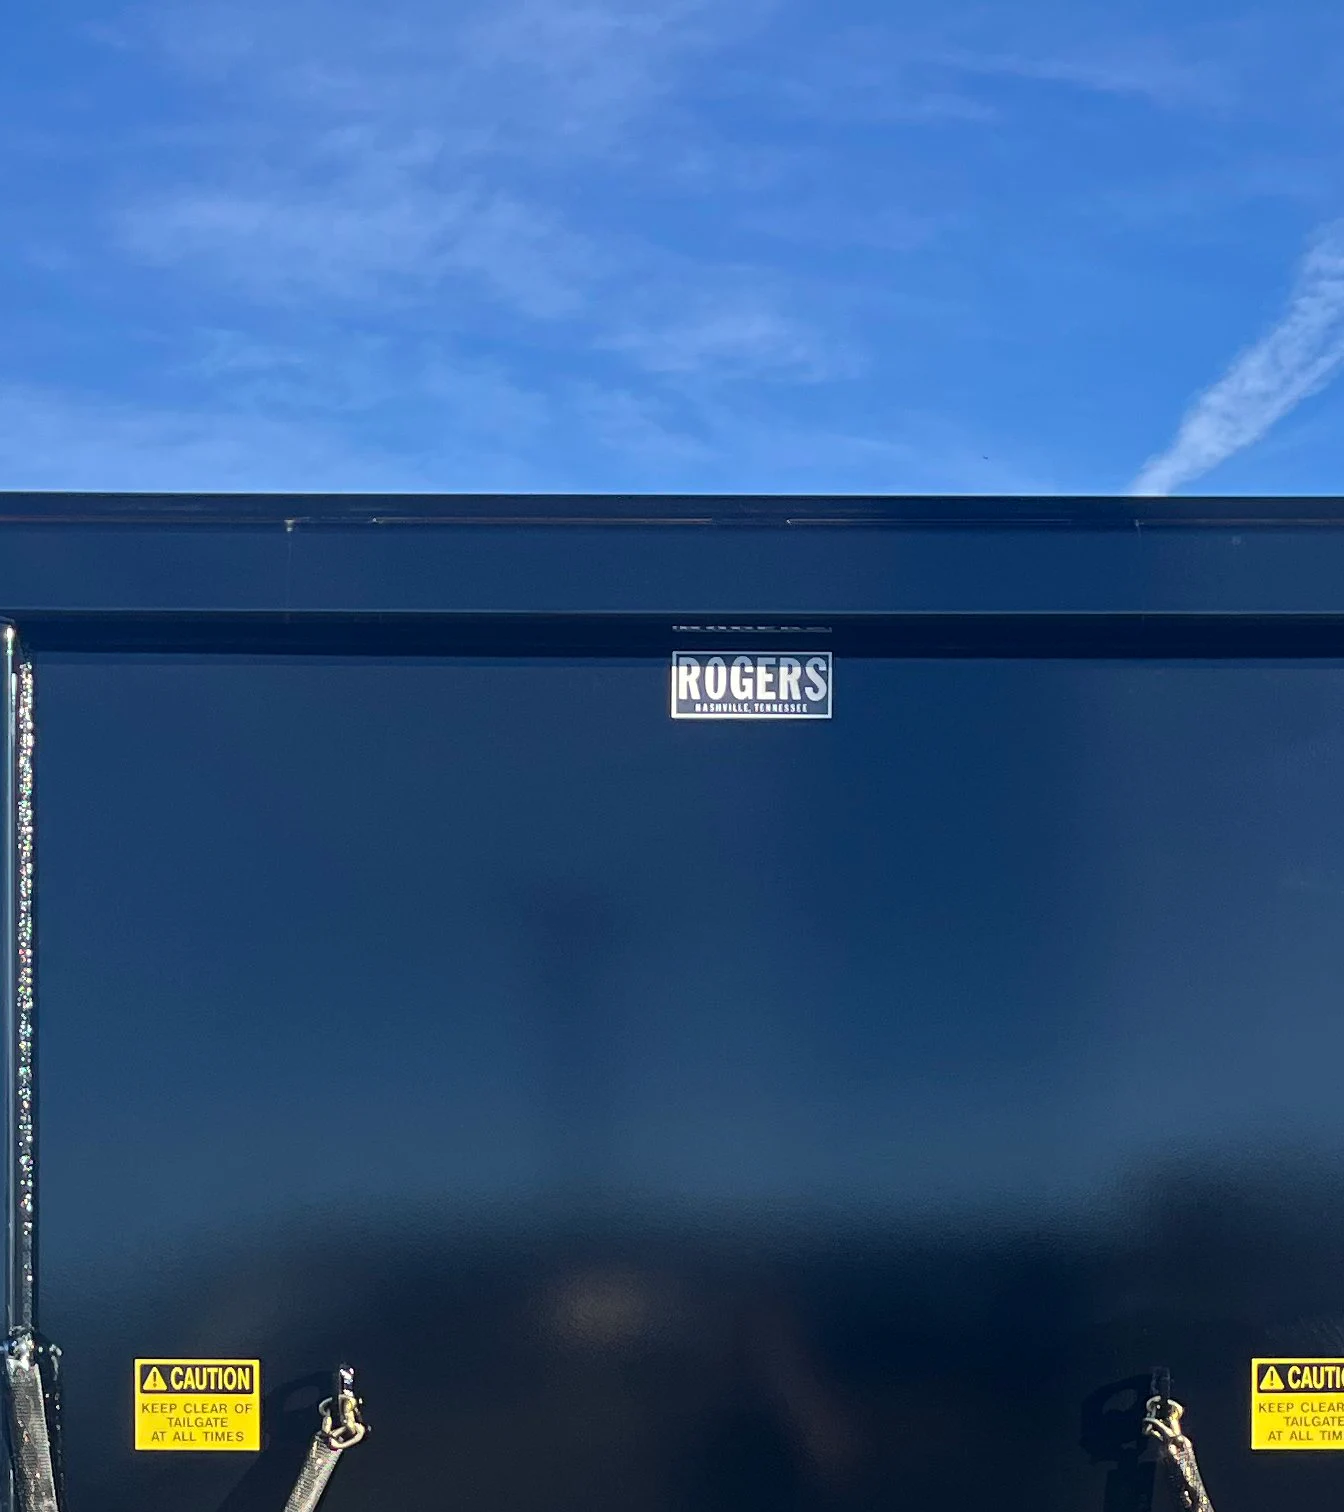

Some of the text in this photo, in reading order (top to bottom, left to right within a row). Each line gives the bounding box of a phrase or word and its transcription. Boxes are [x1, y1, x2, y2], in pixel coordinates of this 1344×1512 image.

[678, 655, 828, 702] ROGERS
[754, 703, 808, 713] TENNESSEE
[170, 1366, 251, 1391] CAUTION
[141, 1403, 253, 1414] KEEP CLEAR OF
[1258, 1402, 1294, 1413] KEEP
[1300, 1402, 1344, 1413] CLEAR
[167, 1417, 229, 1428] TAILGATE
[151, 1431, 244, 1442] AT ALL TIMES
[1267, 1430, 1283, 1441] AT
[1289, 1430, 1314, 1441] ALL
